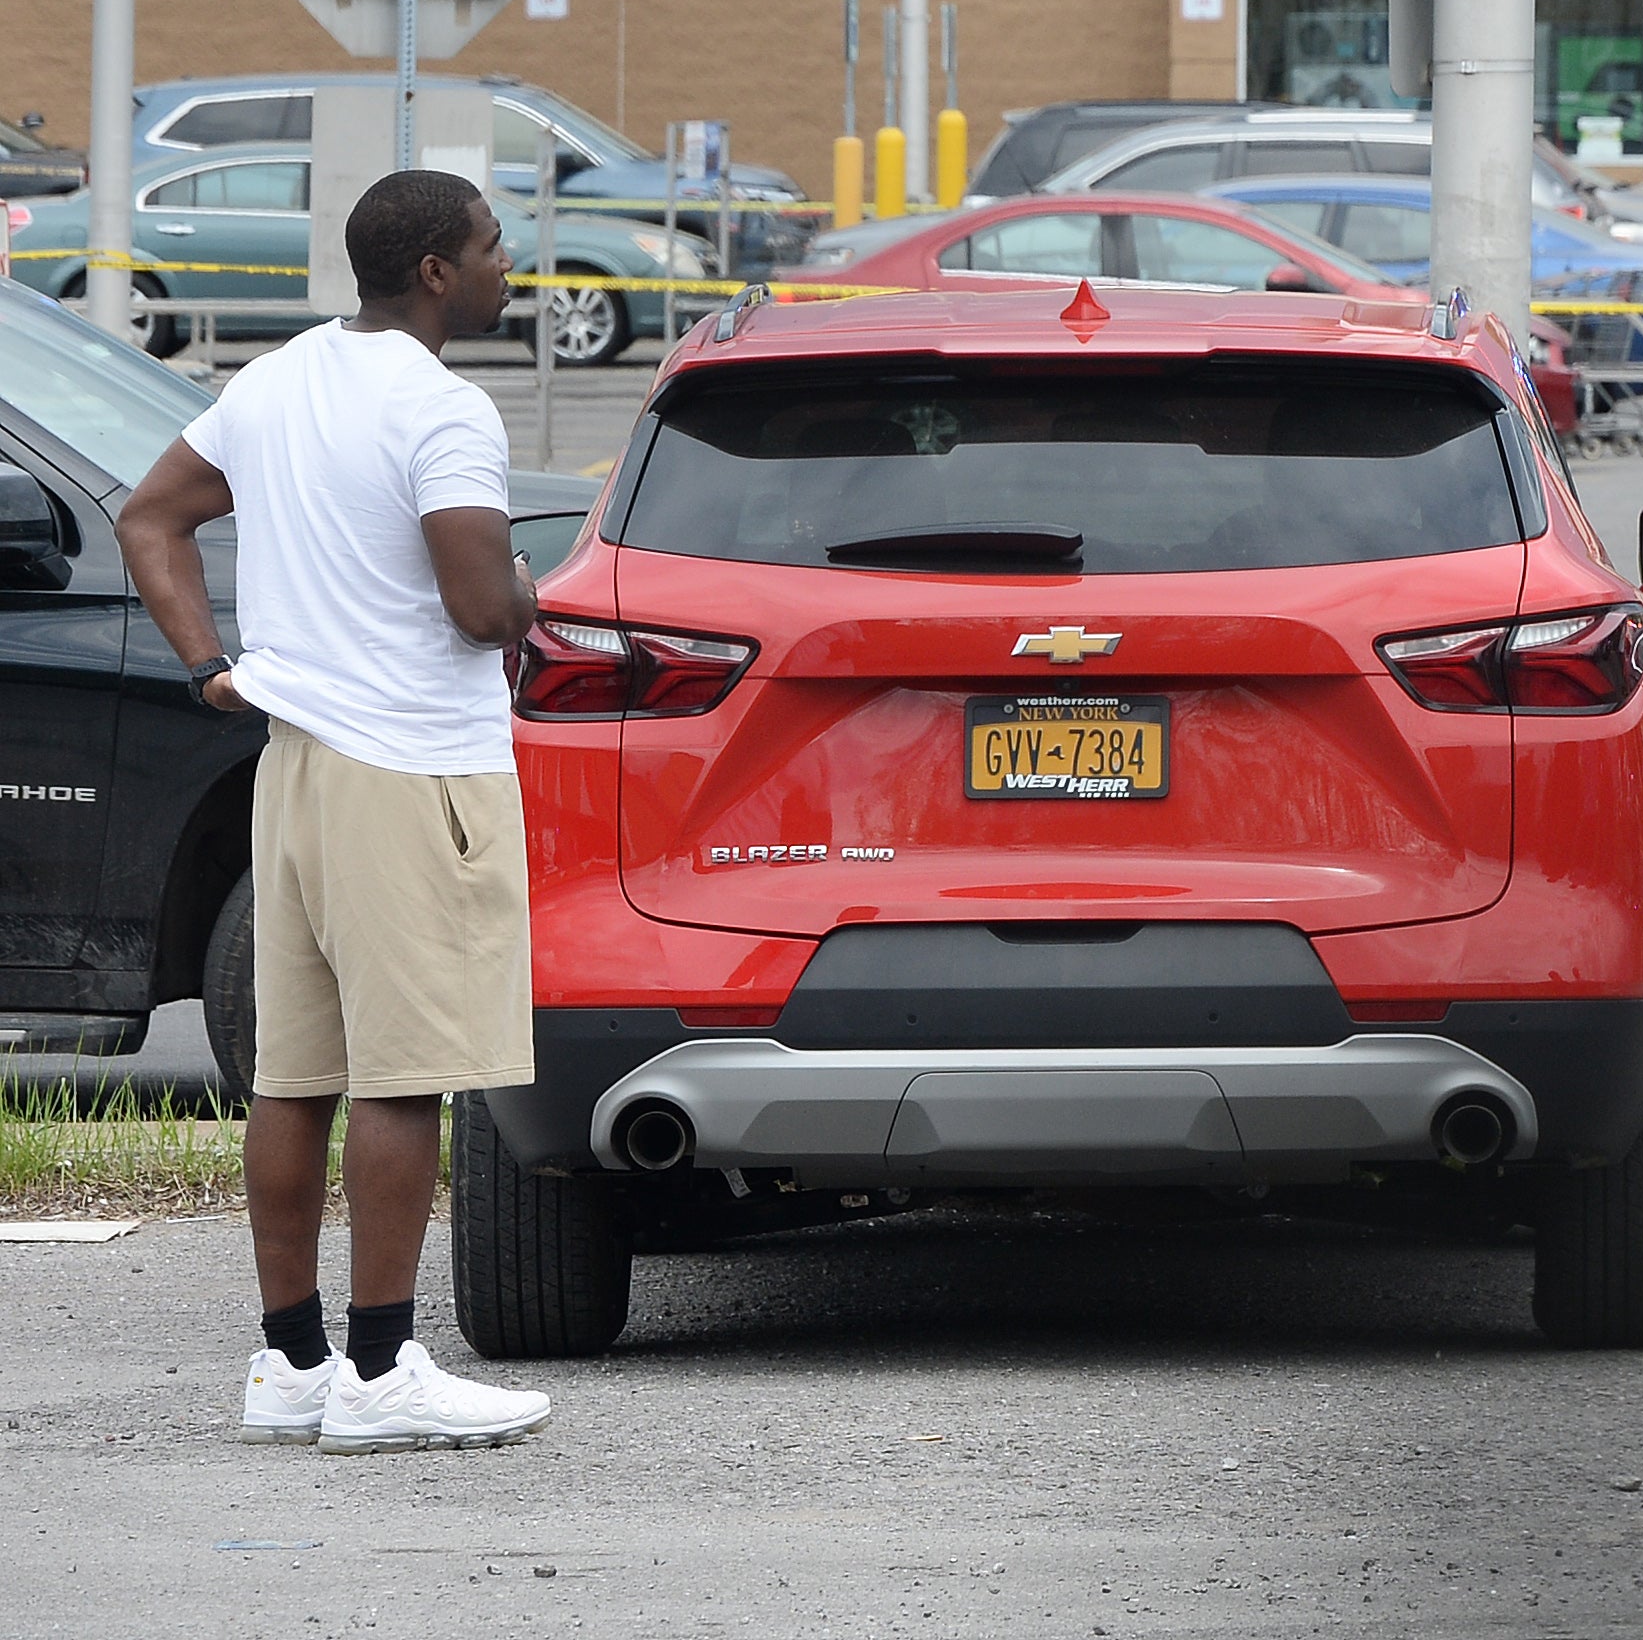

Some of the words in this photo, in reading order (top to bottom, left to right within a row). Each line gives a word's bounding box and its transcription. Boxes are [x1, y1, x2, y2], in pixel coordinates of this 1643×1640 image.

[1017, 696, 1119, 706] westherr.com
[1019, 707, 1064, 721] NEW
[1070, 707, 1118, 721] YORK
[0, 784, 96, 802] AHOE
[711, 845, 828, 863] BLAZER
[841, 847, 896, 862] AWD
